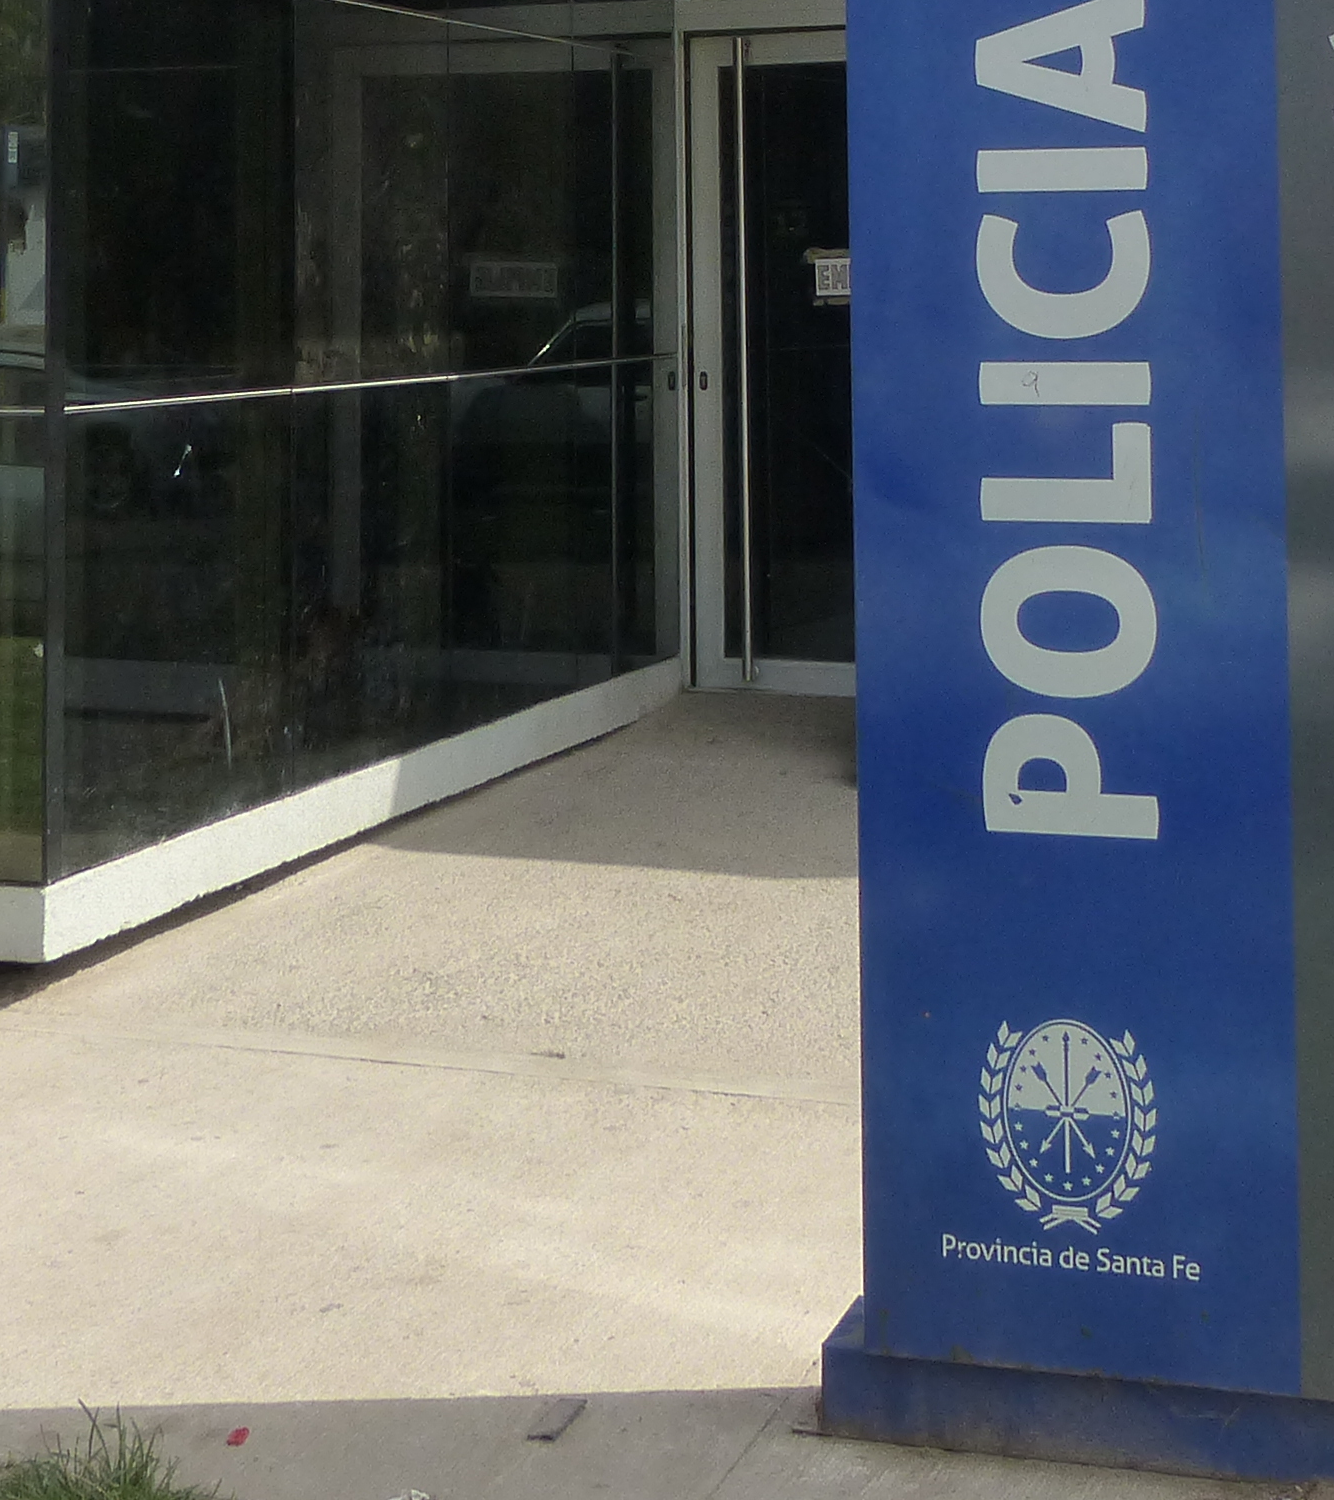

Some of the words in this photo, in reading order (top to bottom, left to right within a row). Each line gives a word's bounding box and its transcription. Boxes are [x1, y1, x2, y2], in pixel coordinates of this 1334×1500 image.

[942, 1233, 1052, 1267] Provincia
[1059, 1246, 1090, 1271] de
[1096, 1248, 1165, 1277] Santa
[1172, 1254, 1201, 1281] Fe
